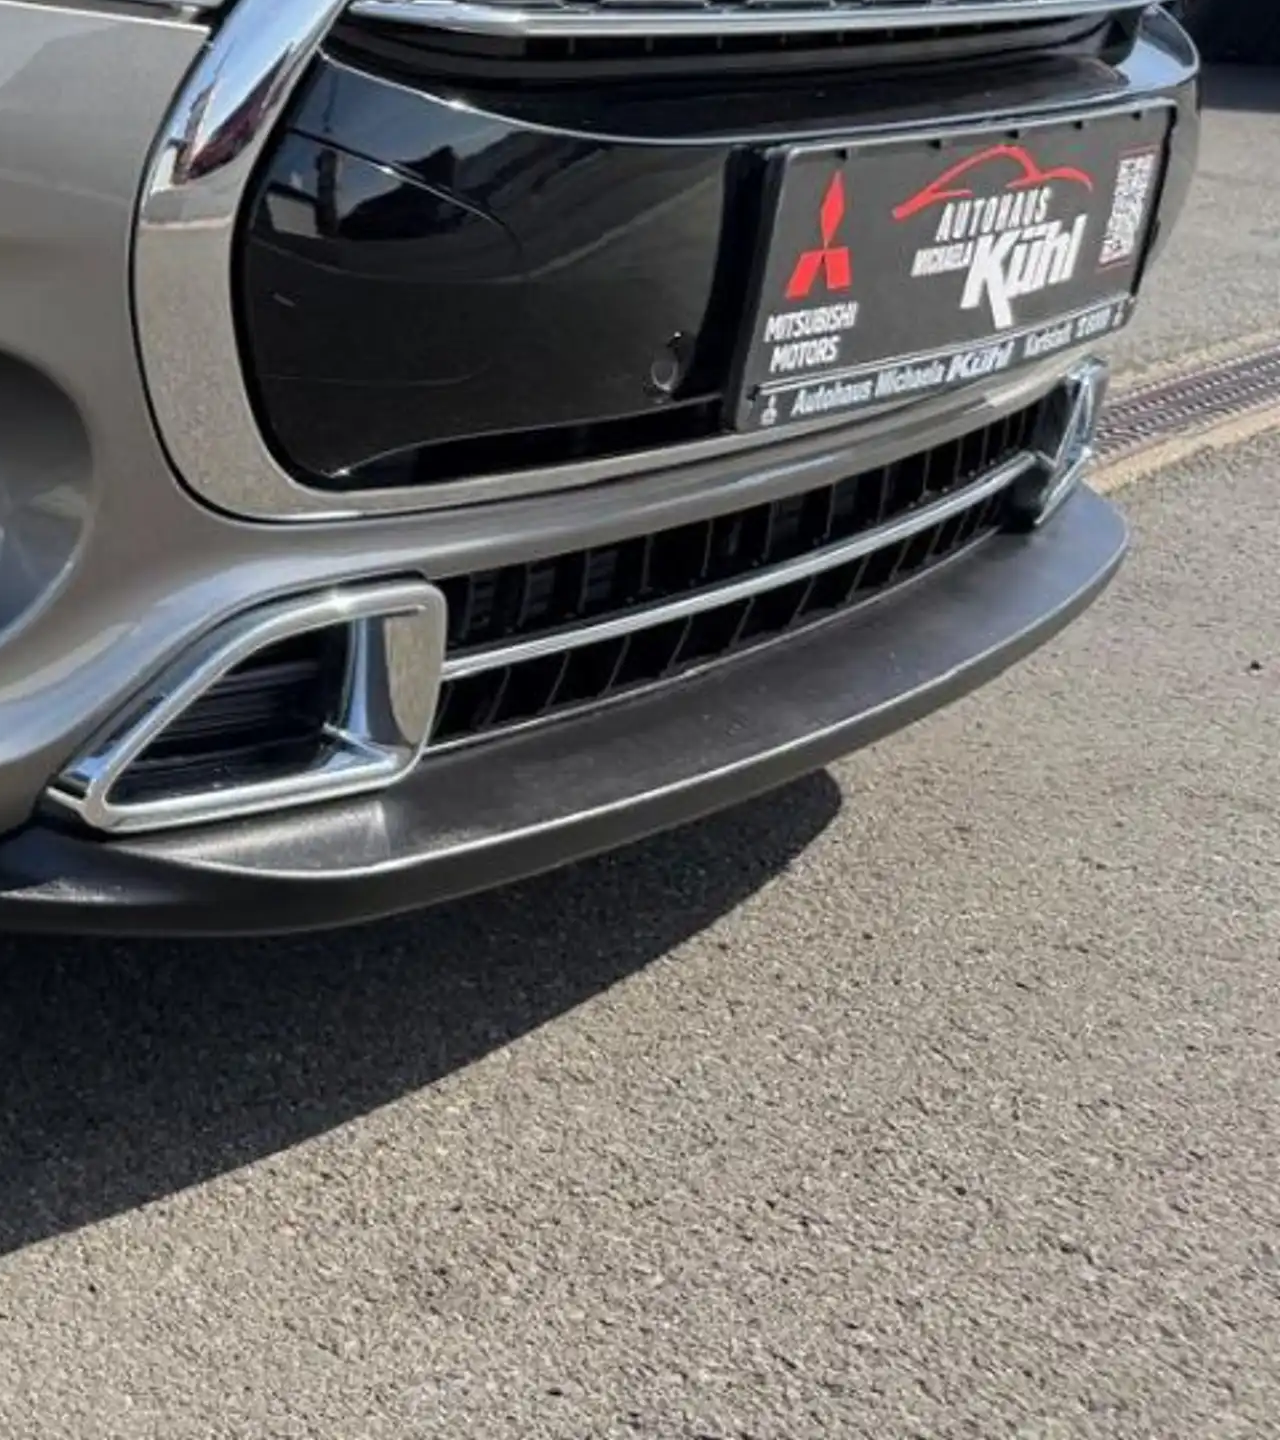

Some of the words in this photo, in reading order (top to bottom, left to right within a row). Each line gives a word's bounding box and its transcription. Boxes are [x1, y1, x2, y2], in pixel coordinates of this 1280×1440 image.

[936, 187, 1052, 242] AUTOHAUS
[960, 213, 1088, 330] Kühl
[763, 300, 859, 343] MITSUBISHI
[769, 335, 841, 374] MOTORS
[791, 379, 873, 416] Autohaus
[946, 338, 1016, 383] Kühl
